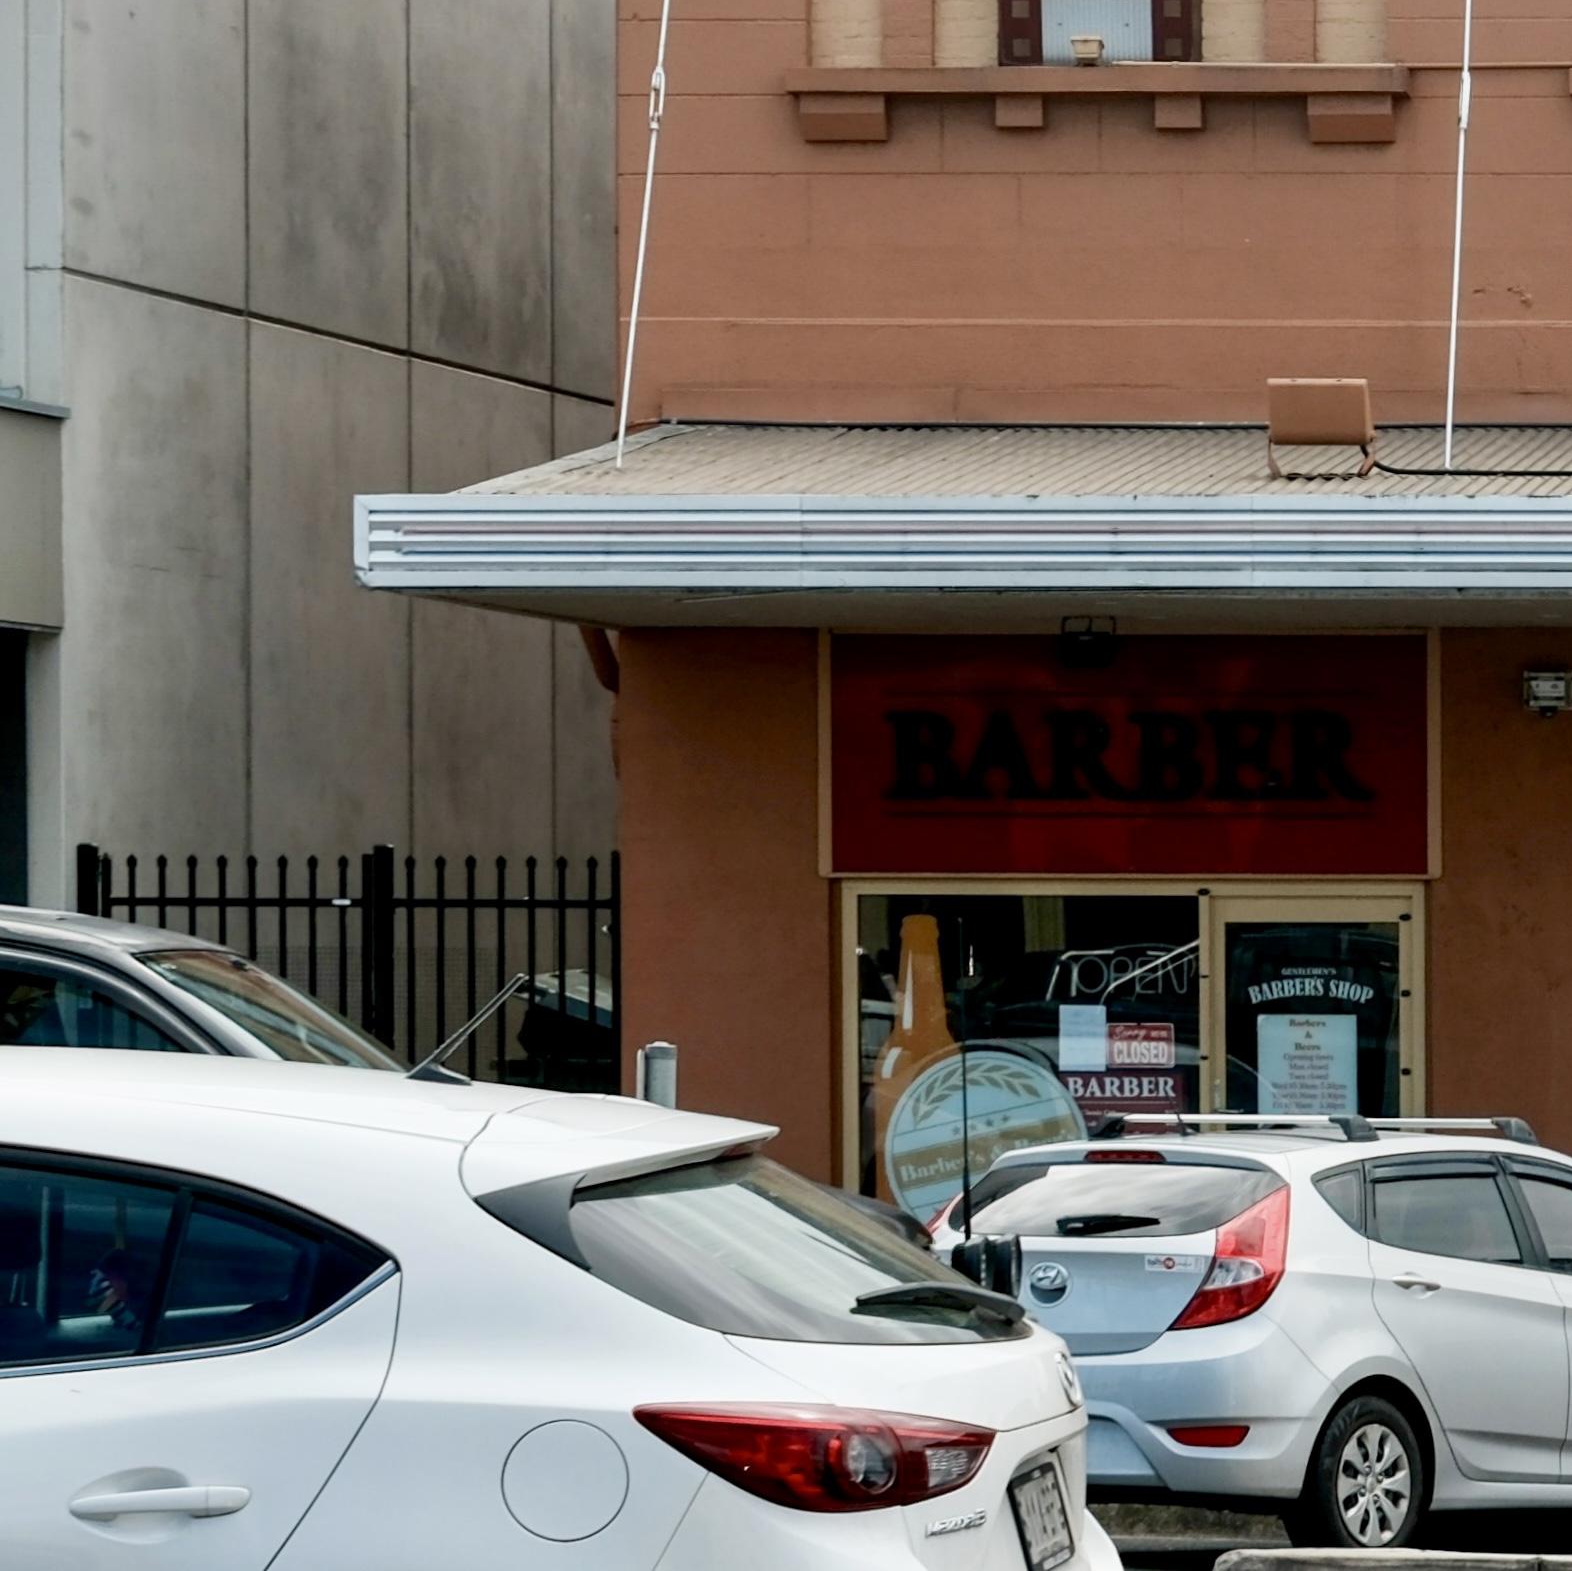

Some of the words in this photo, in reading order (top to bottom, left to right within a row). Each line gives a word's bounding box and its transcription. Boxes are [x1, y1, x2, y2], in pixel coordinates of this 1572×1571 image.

[881, 709, 1377, 802] BARBER
[1076, 955, 1189, 995] OPEN
[1247, 975, 1325, 1005] BARBER'S
[1328, 979, 1375, 1005] SHOP
[1114, 1041, 1169, 1065] CLOSED
[1066, 1076, 1177, 1098] BARBER
